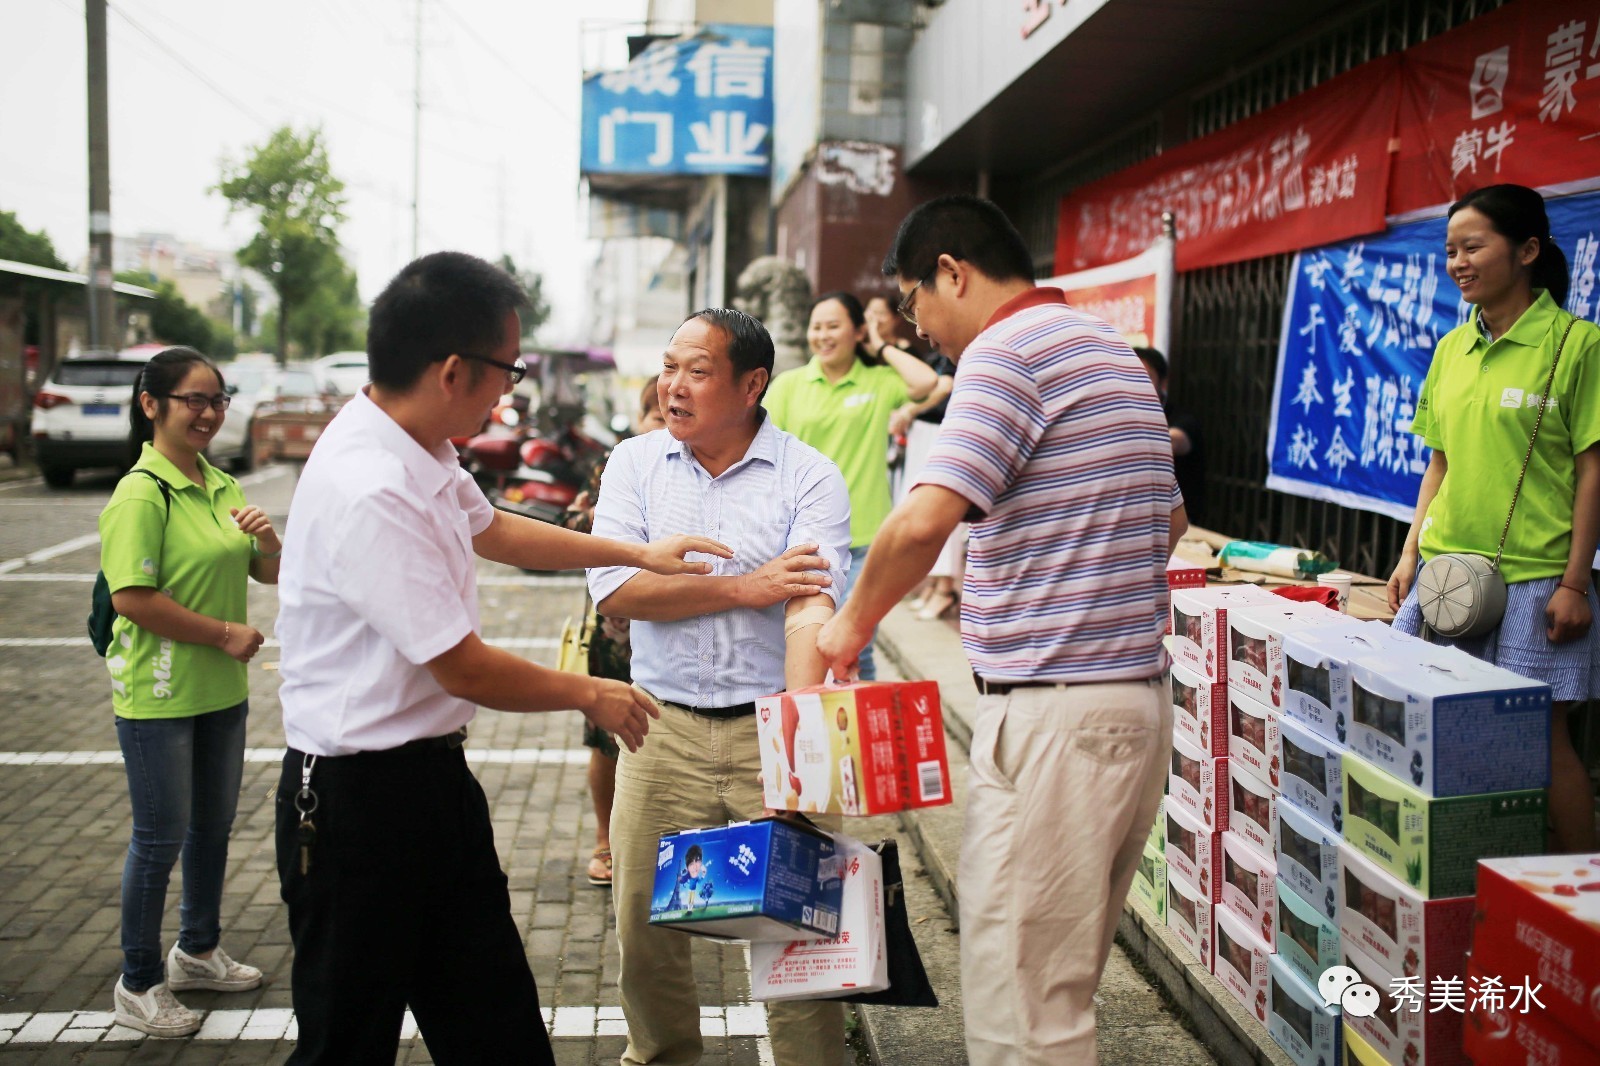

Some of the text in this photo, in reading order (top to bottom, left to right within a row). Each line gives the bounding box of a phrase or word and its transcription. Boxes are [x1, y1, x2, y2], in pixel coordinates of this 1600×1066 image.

[1538, 19, 1600, 124] 蒙
[599, 107, 769, 166] 门业
[1451, 120, 1517, 180] 蒙牛
